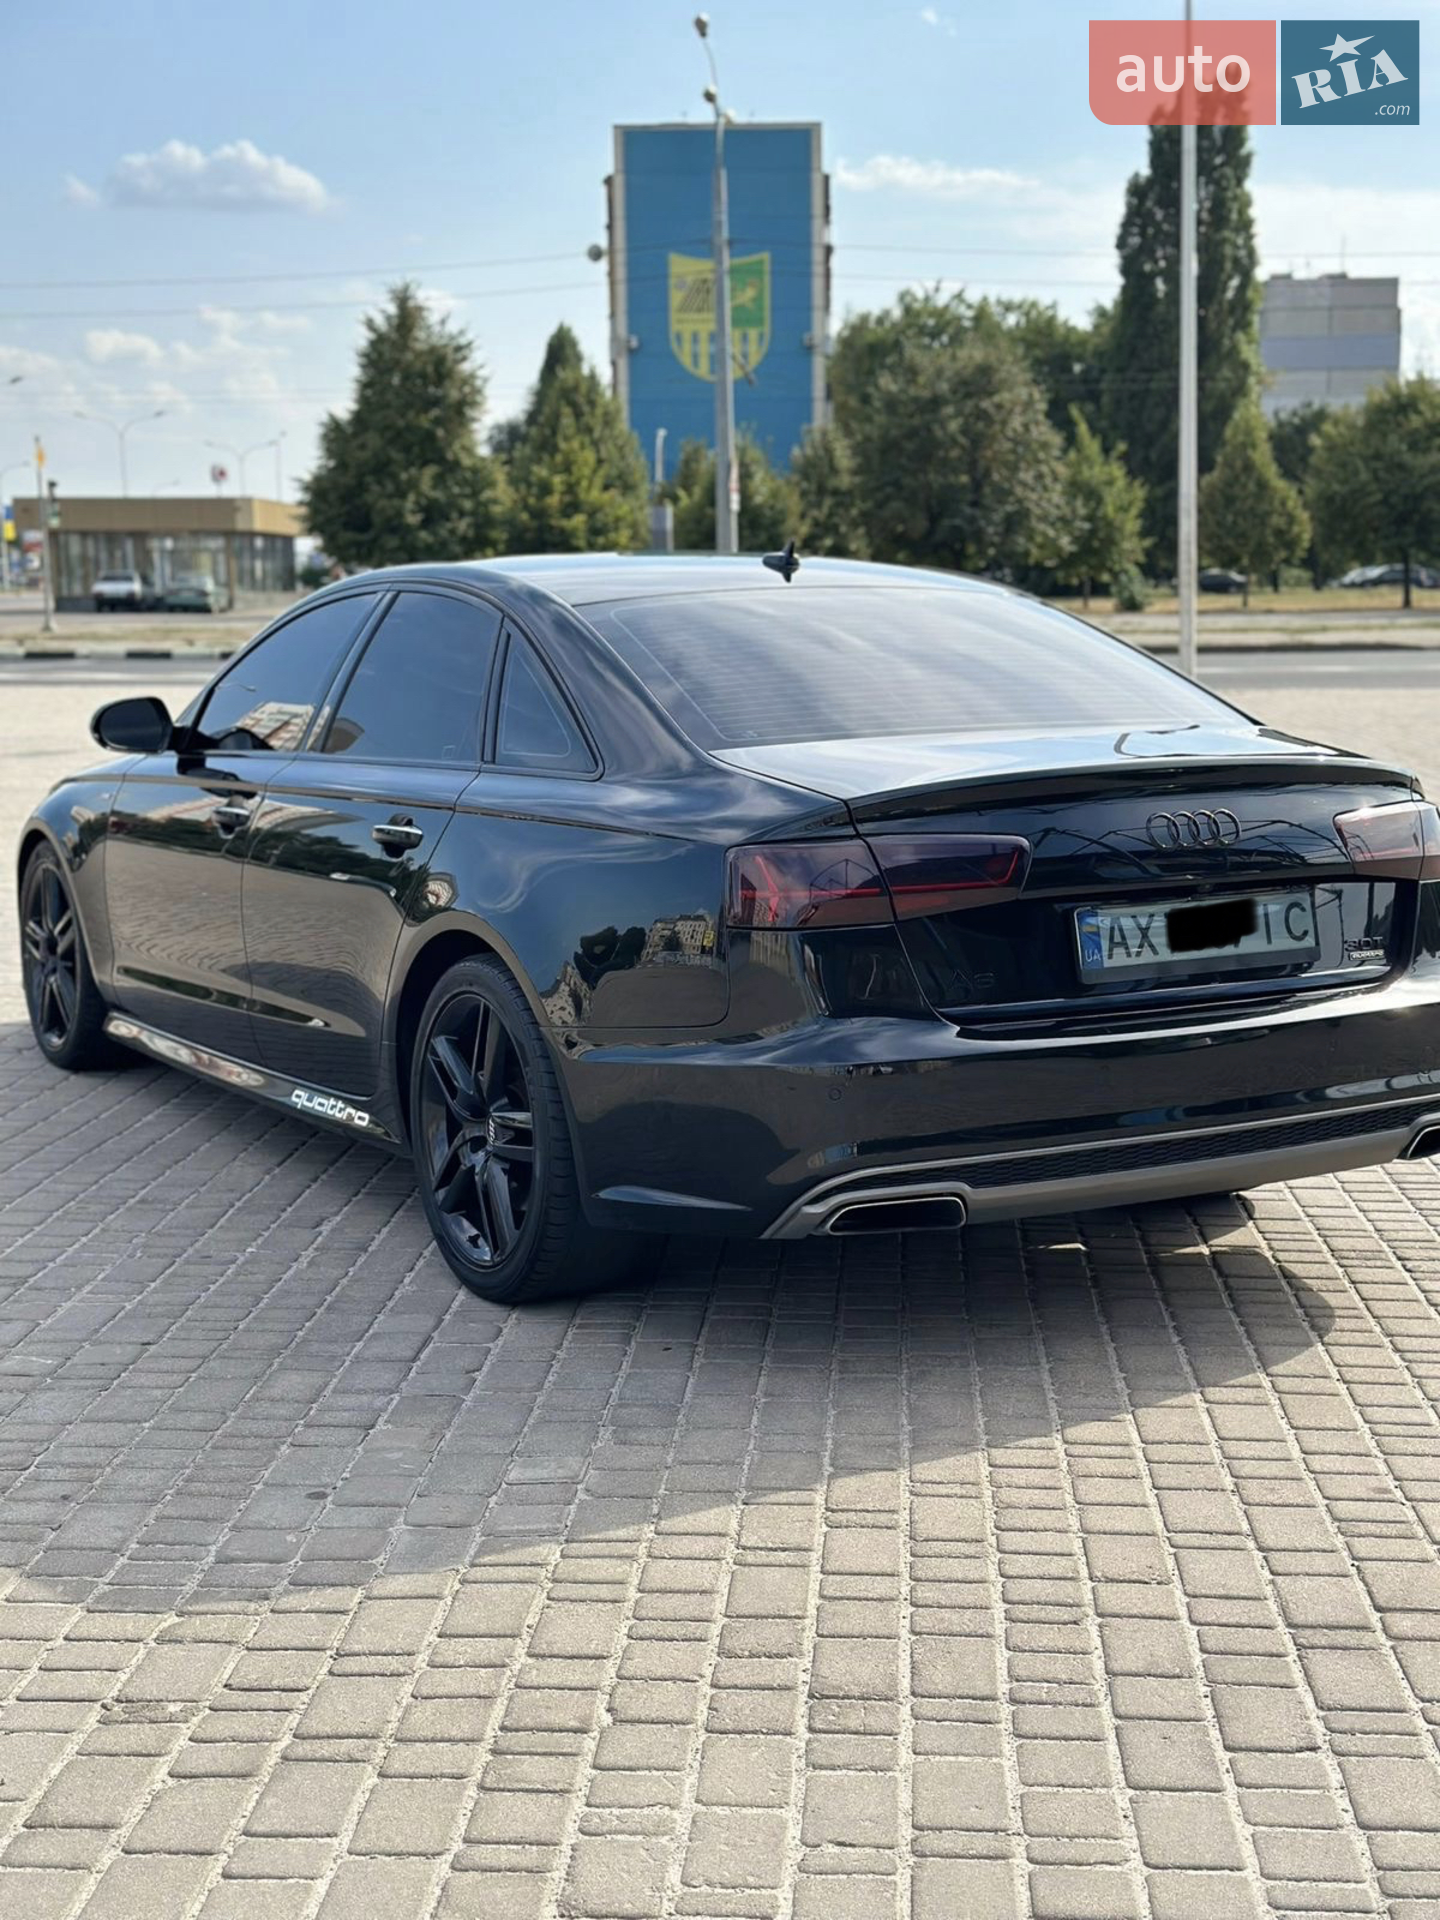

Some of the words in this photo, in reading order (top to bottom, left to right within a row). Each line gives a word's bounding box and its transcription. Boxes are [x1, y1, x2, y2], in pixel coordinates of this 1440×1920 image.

[1084, 948, 1102, 963] UA
[1107, 913, 1160, 960] AX
[291, 1088, 370, 1127] quattro
